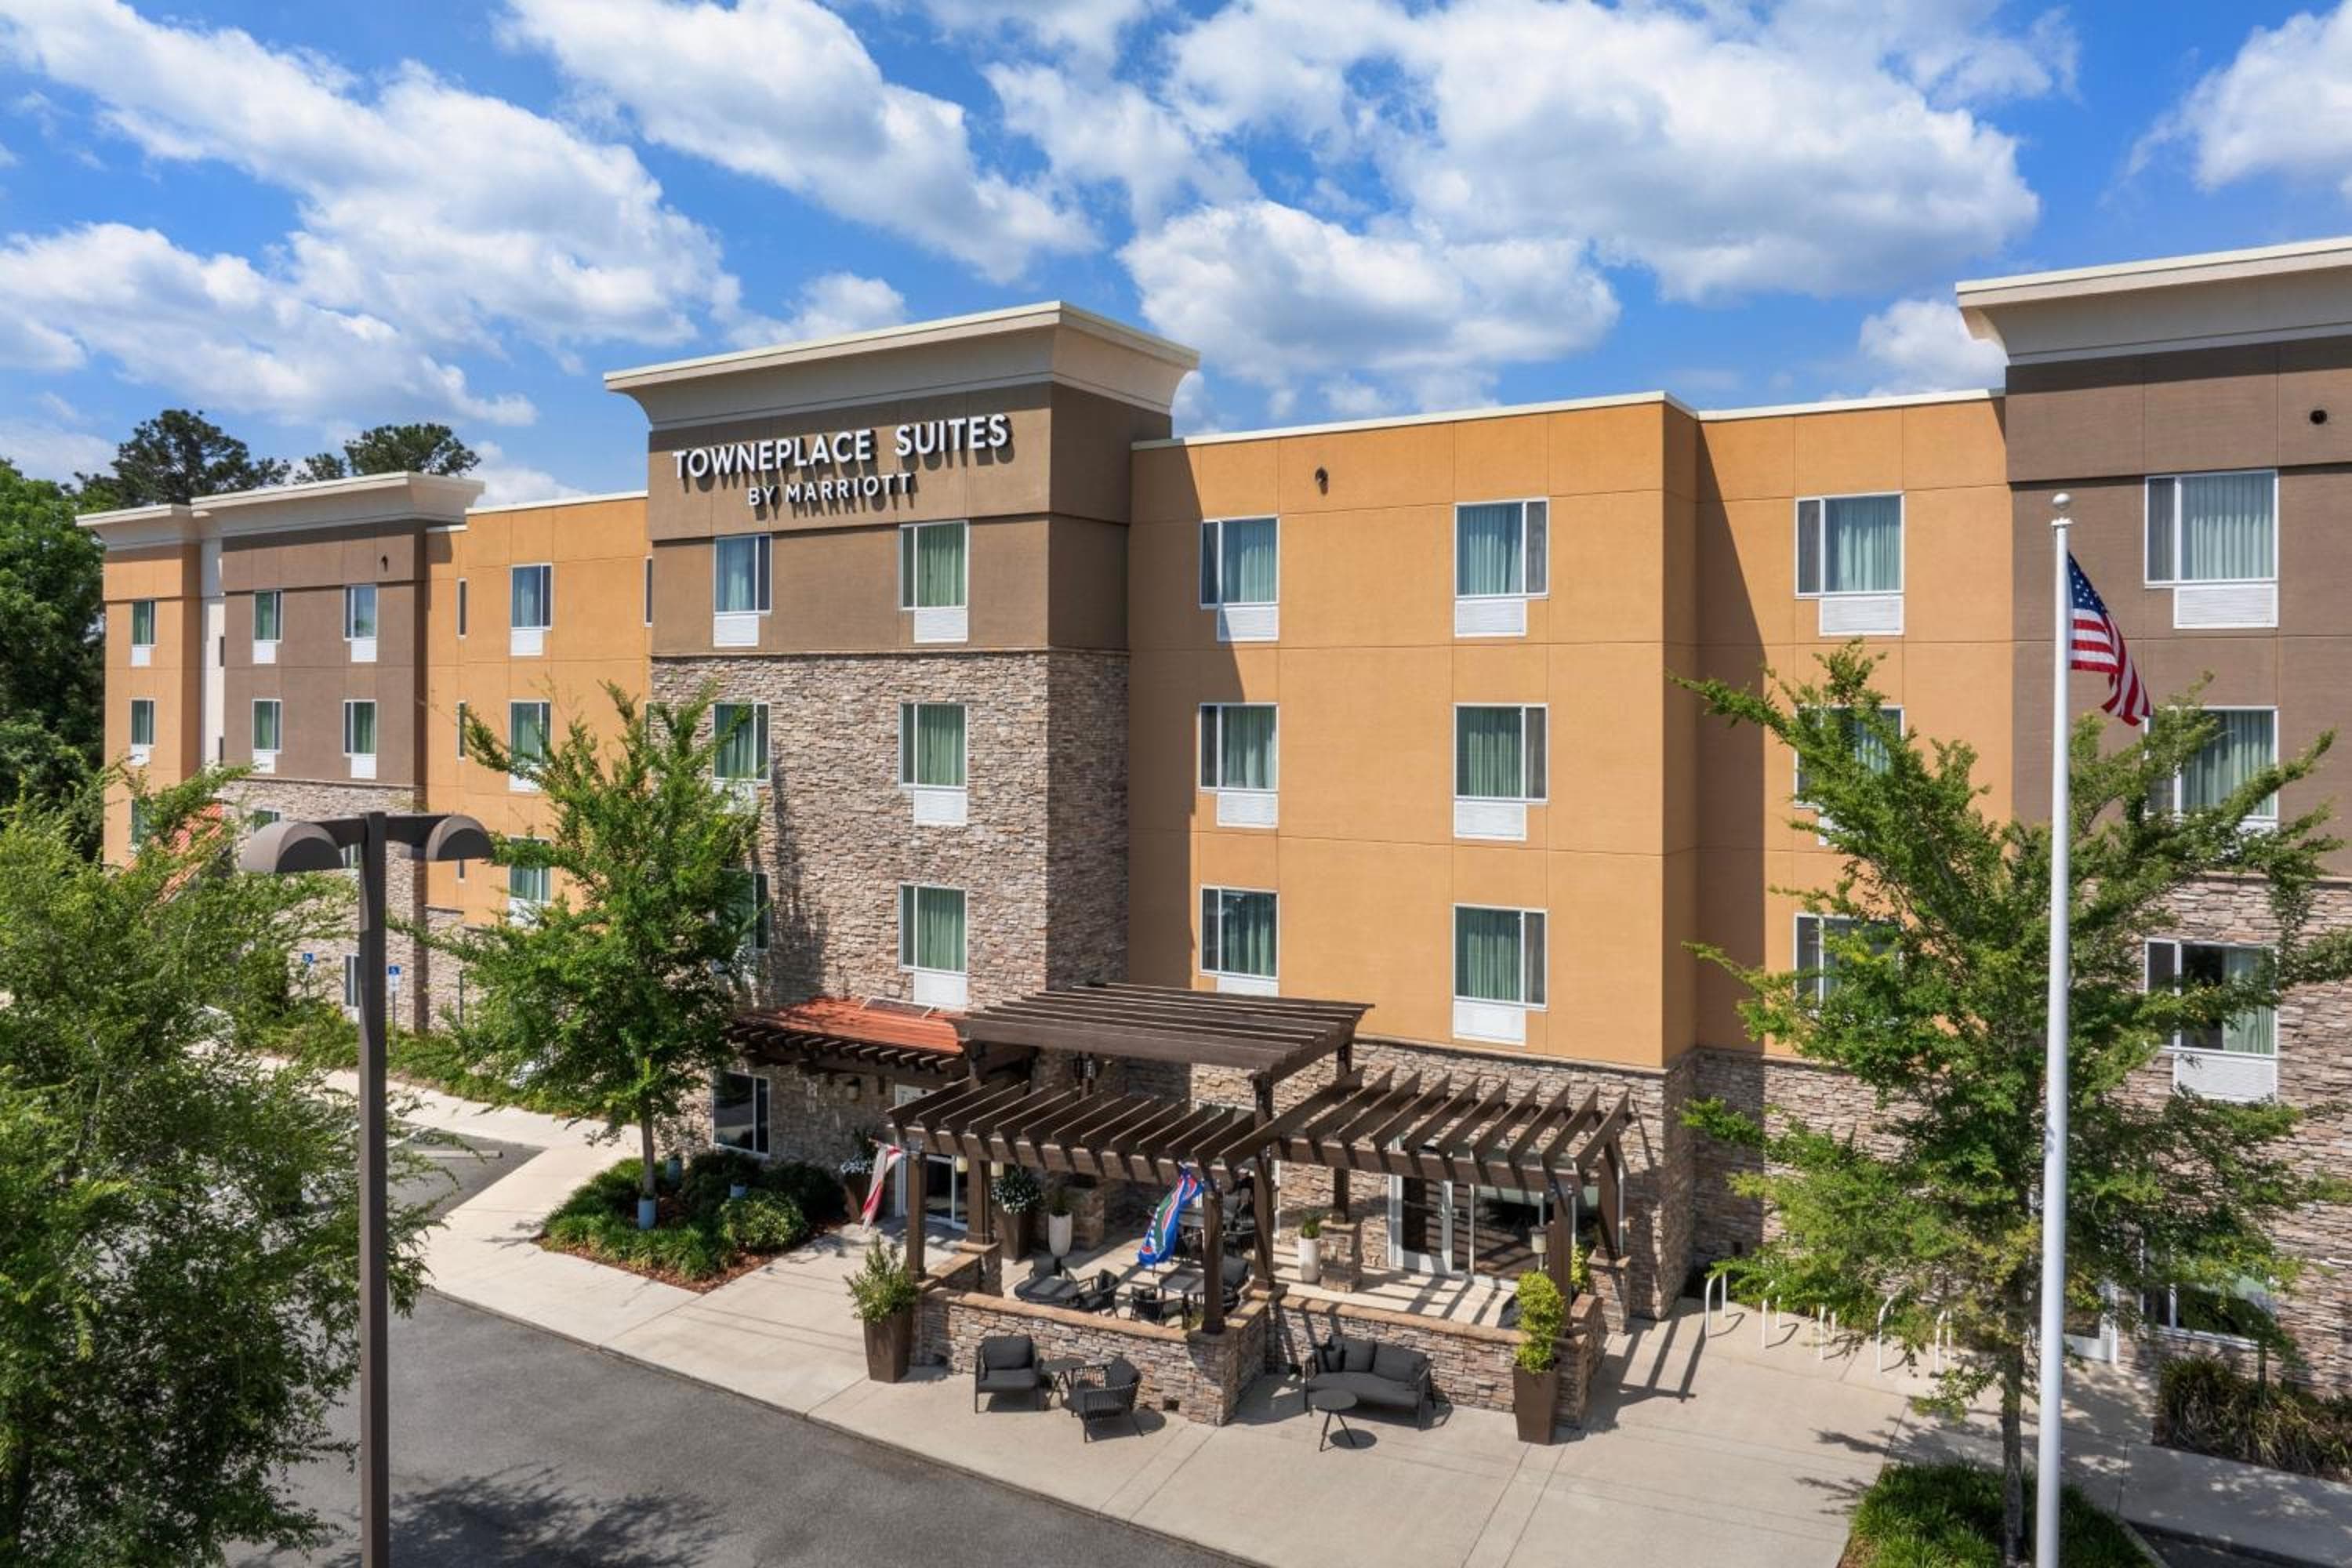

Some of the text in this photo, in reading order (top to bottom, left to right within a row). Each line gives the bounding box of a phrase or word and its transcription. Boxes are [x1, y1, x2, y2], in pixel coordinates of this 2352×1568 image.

[672, 413, 1007, 479] TOWNEPLACE SUITES
[747, 473, 911, 506] BY MARRIOTT
